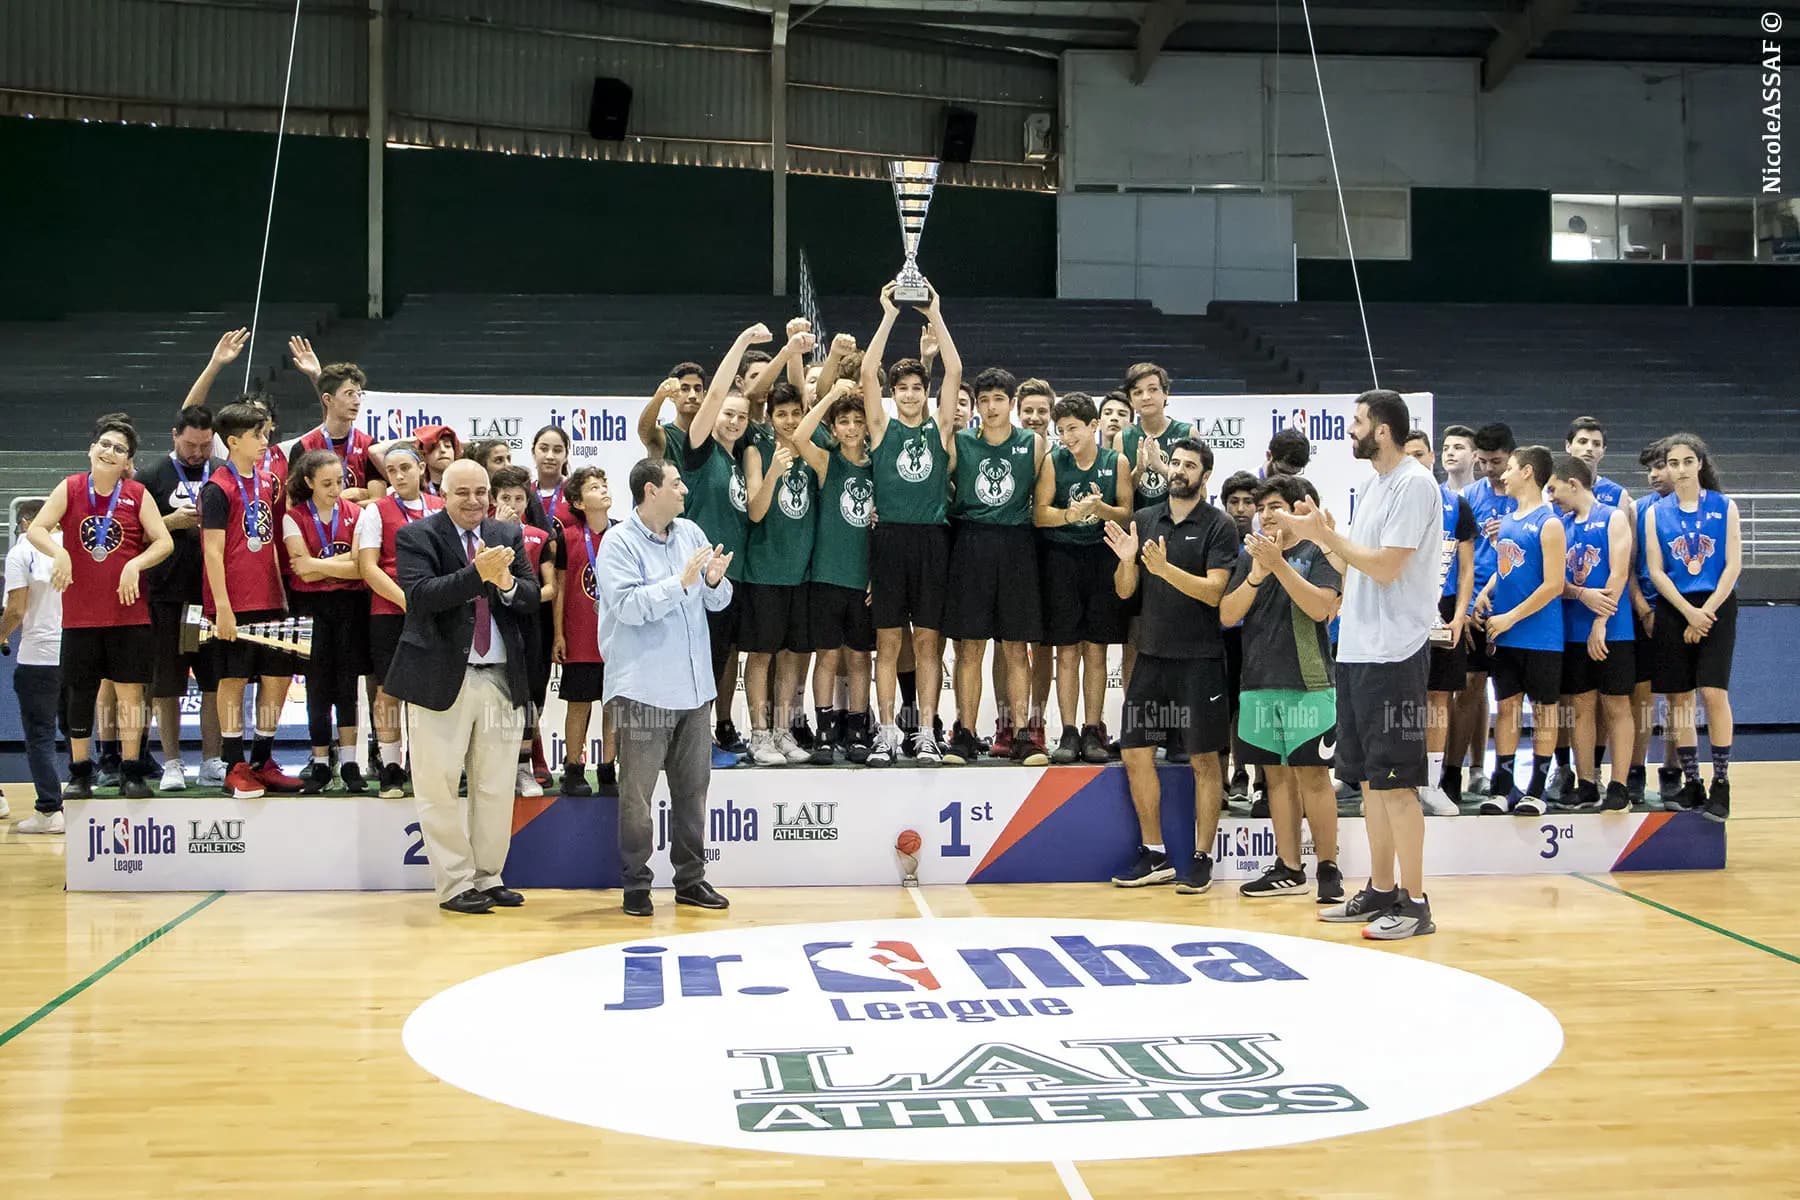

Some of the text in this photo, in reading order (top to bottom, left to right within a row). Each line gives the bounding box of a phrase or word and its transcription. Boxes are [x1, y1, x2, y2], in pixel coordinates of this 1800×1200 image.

[469, 417, 523, 437] LAU
[590, 409, 627, 441] nba
[1193, 416, 1245, 437] LAU
[1309, 409, 1345, 441] nba
[572, 444, 598, 459] League
[710, 800, 758, 842] nba
[772, 802, 839, 827] LAU
[938, 801, 993, 857] 1st
[87, 817, 176, 862] jr. nba
[188, 819, 246, 841] LAU
[773, 828, 839, 841] ATHLETICS
[1216, 827, 1278, 862] jr. nb
[1540, 824, 1574, 859] 3rd
[188, 842, 246, 854] ATHLETICS
[114, 857, 143, 874] League
[1236, 859, 1260, 872] League
[604, 935, 1309, 1011] jr. nba
[829, 997, 1074, 1023] League
[727, 1032, 1285, 1100] LAU
[752, 1086, 1356, 1131] ATHLETICS
